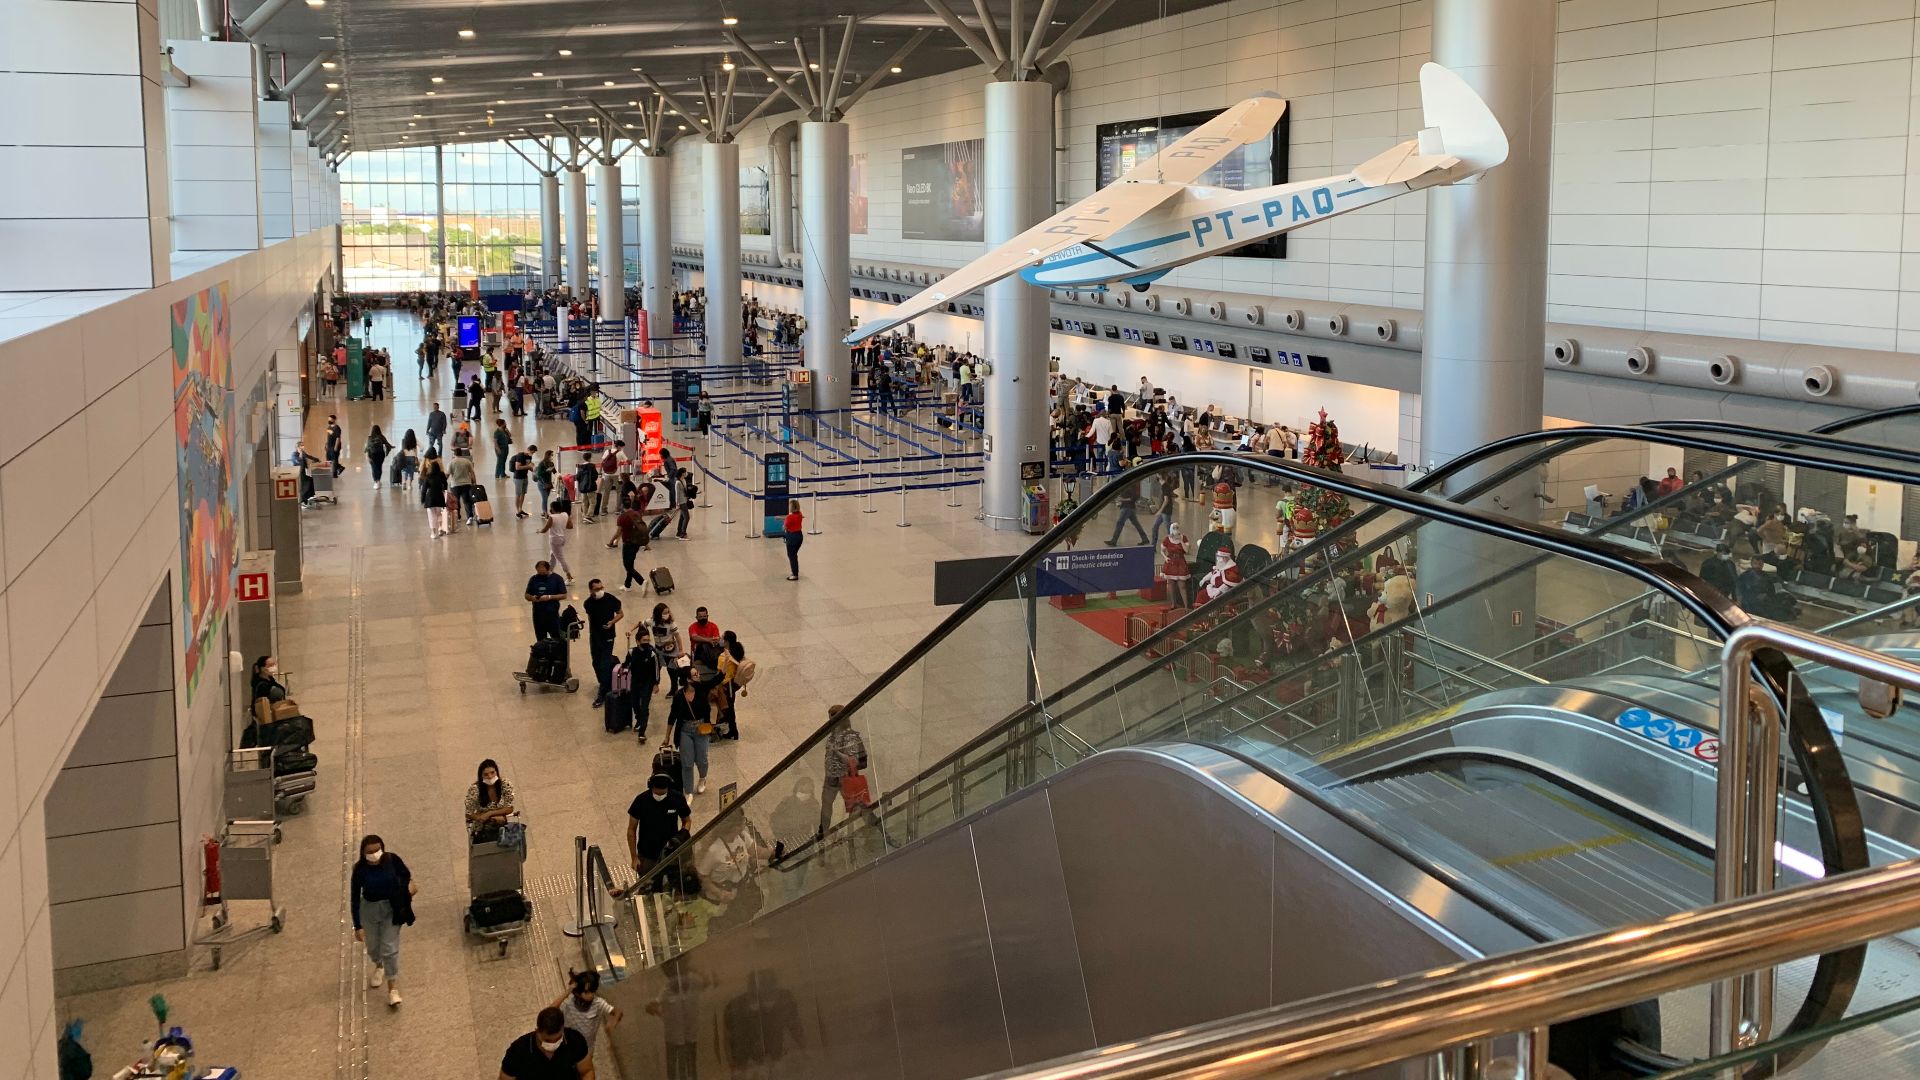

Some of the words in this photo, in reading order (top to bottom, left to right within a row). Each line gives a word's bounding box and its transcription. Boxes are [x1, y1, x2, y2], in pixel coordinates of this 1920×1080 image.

[800, 372, 809, 382] H
[279, 481, 295, 497] H
[1097, 560, 1119, 568] check-in
[244, 577, 264, 597] H
